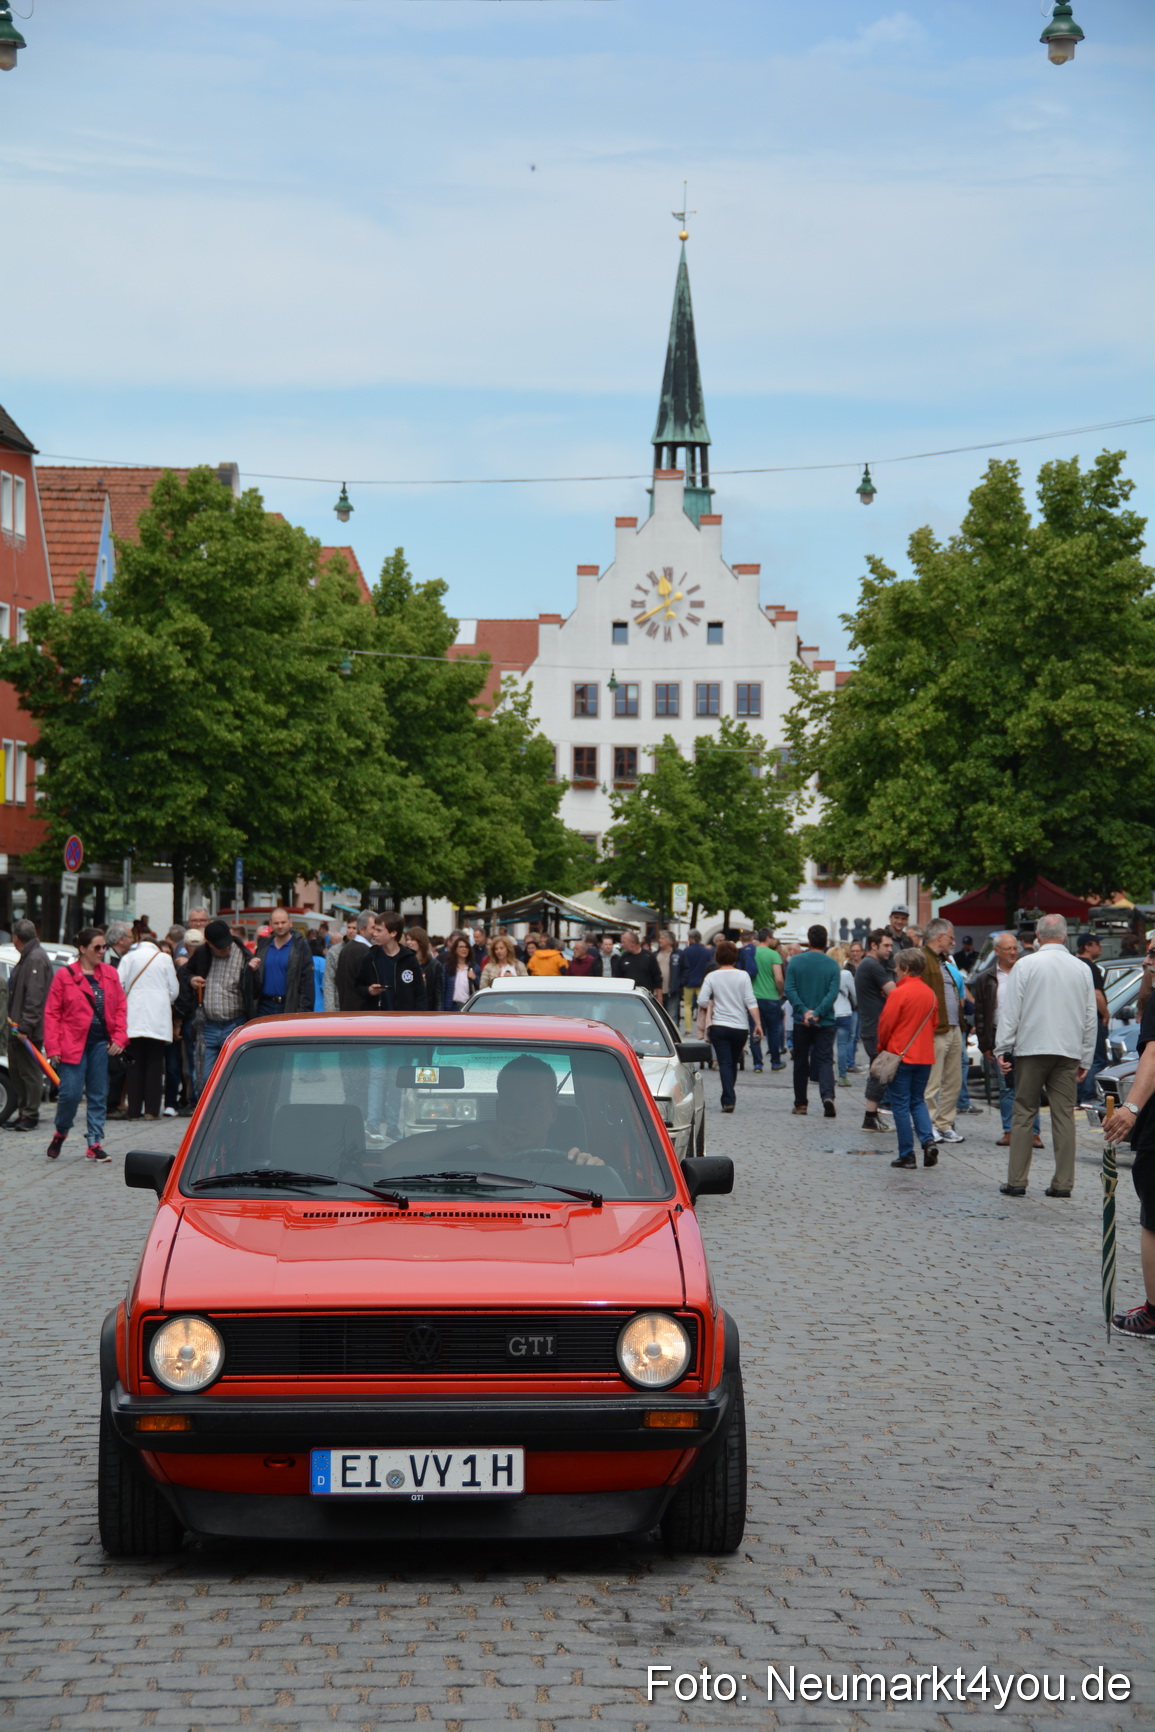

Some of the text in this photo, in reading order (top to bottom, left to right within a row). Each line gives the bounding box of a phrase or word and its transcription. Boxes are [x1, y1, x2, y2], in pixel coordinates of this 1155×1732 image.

[509, 1337, 553, 1356] GTI
[317, 1475, 325, 1486] D
[341, 1454, 382, 1488] EI
